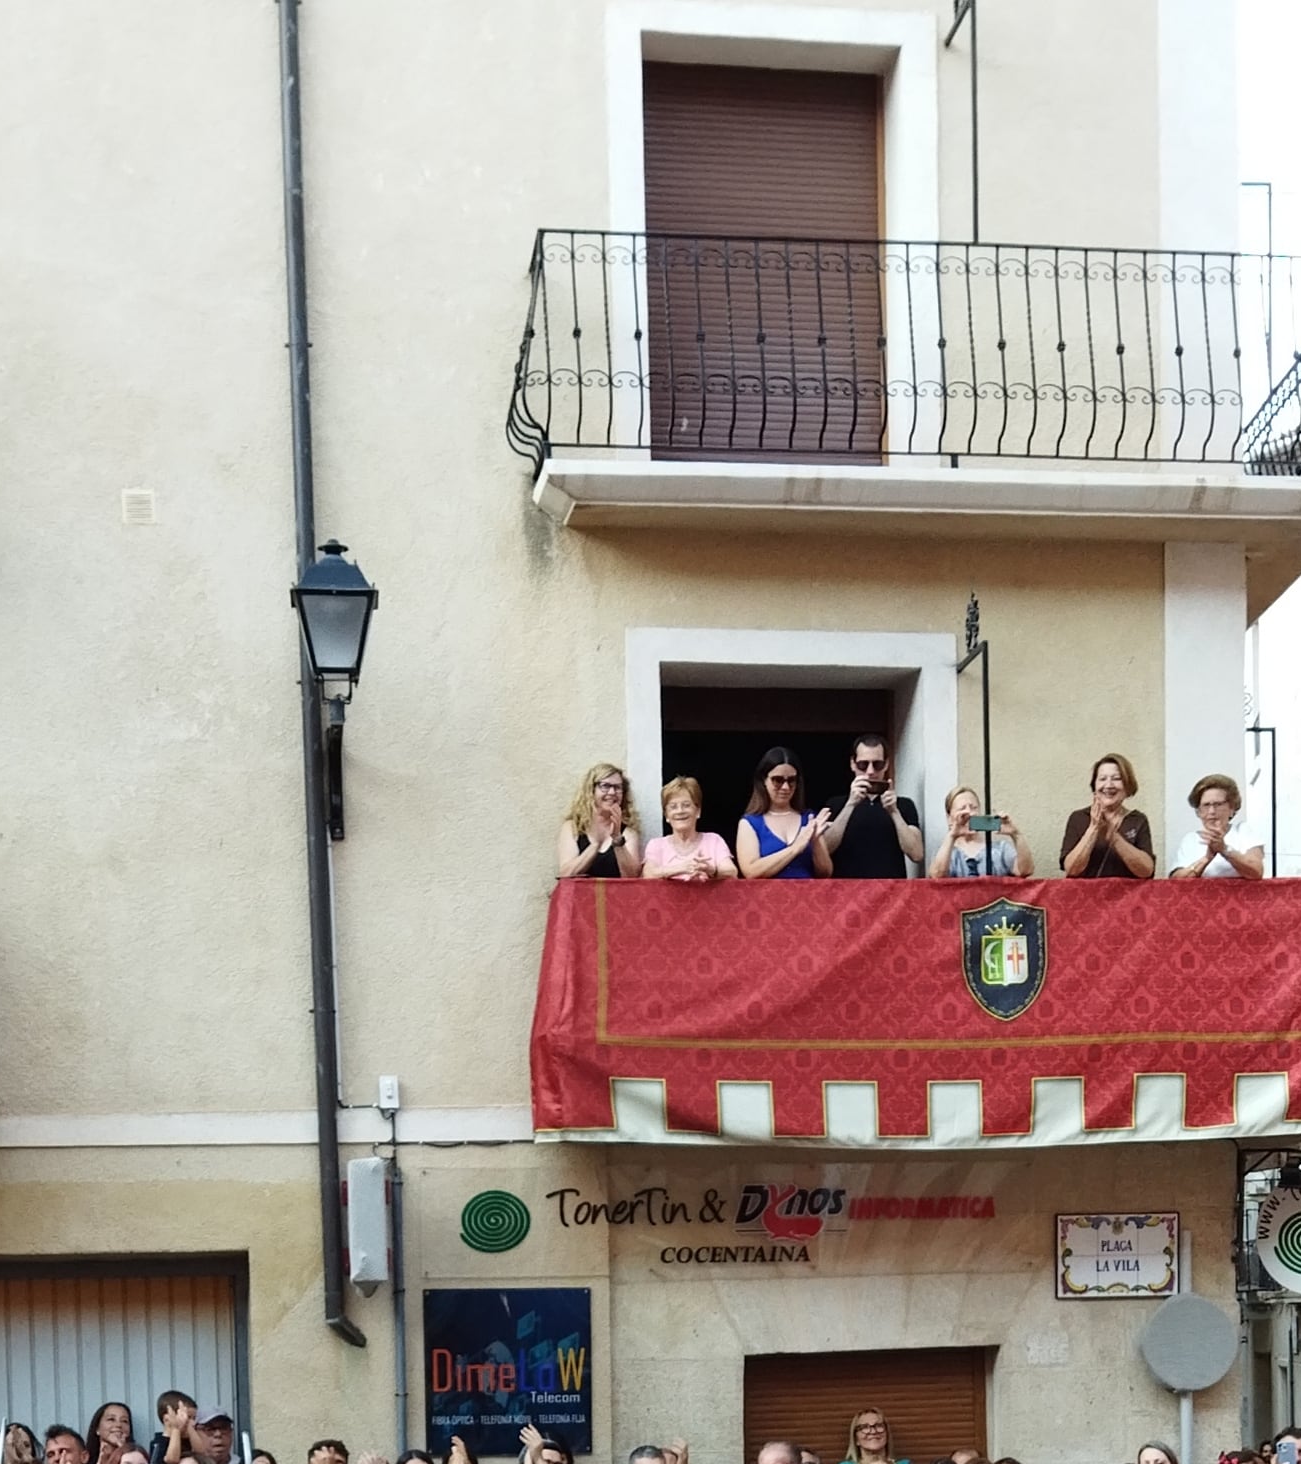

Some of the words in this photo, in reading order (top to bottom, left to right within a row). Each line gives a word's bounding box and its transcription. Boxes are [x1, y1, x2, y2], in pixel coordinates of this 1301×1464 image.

[546, 1188, 691, 1227] TonerTin
[699, 1189, 727, 1224] &
[660, 1246, 811, 1264] COCENTAINA
[1096, 1260, 1110, 1272] LA
[1114, 1259, 1140, 1272] VILA
[530, 1391, 580, 1403] Telecom
